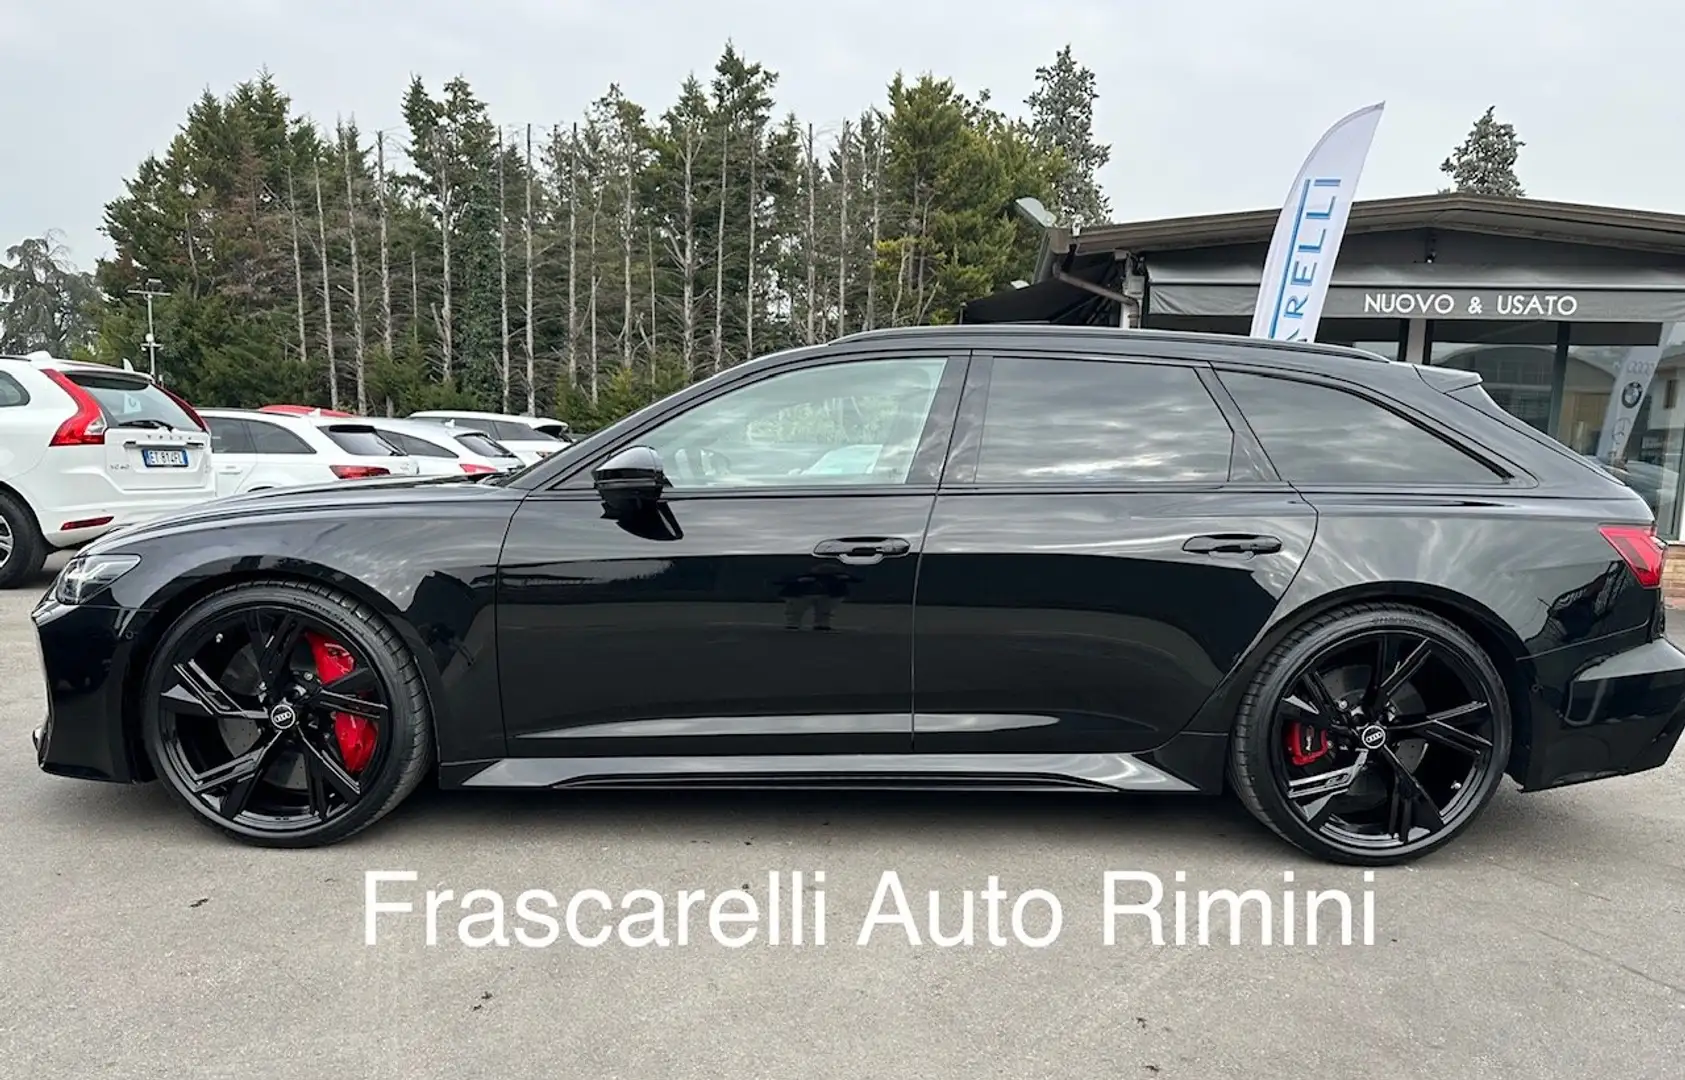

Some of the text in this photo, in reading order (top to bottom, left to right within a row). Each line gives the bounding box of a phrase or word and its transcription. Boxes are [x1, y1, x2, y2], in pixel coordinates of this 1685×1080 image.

[1363, 293, 1578, 316] NUOVO & USATO
